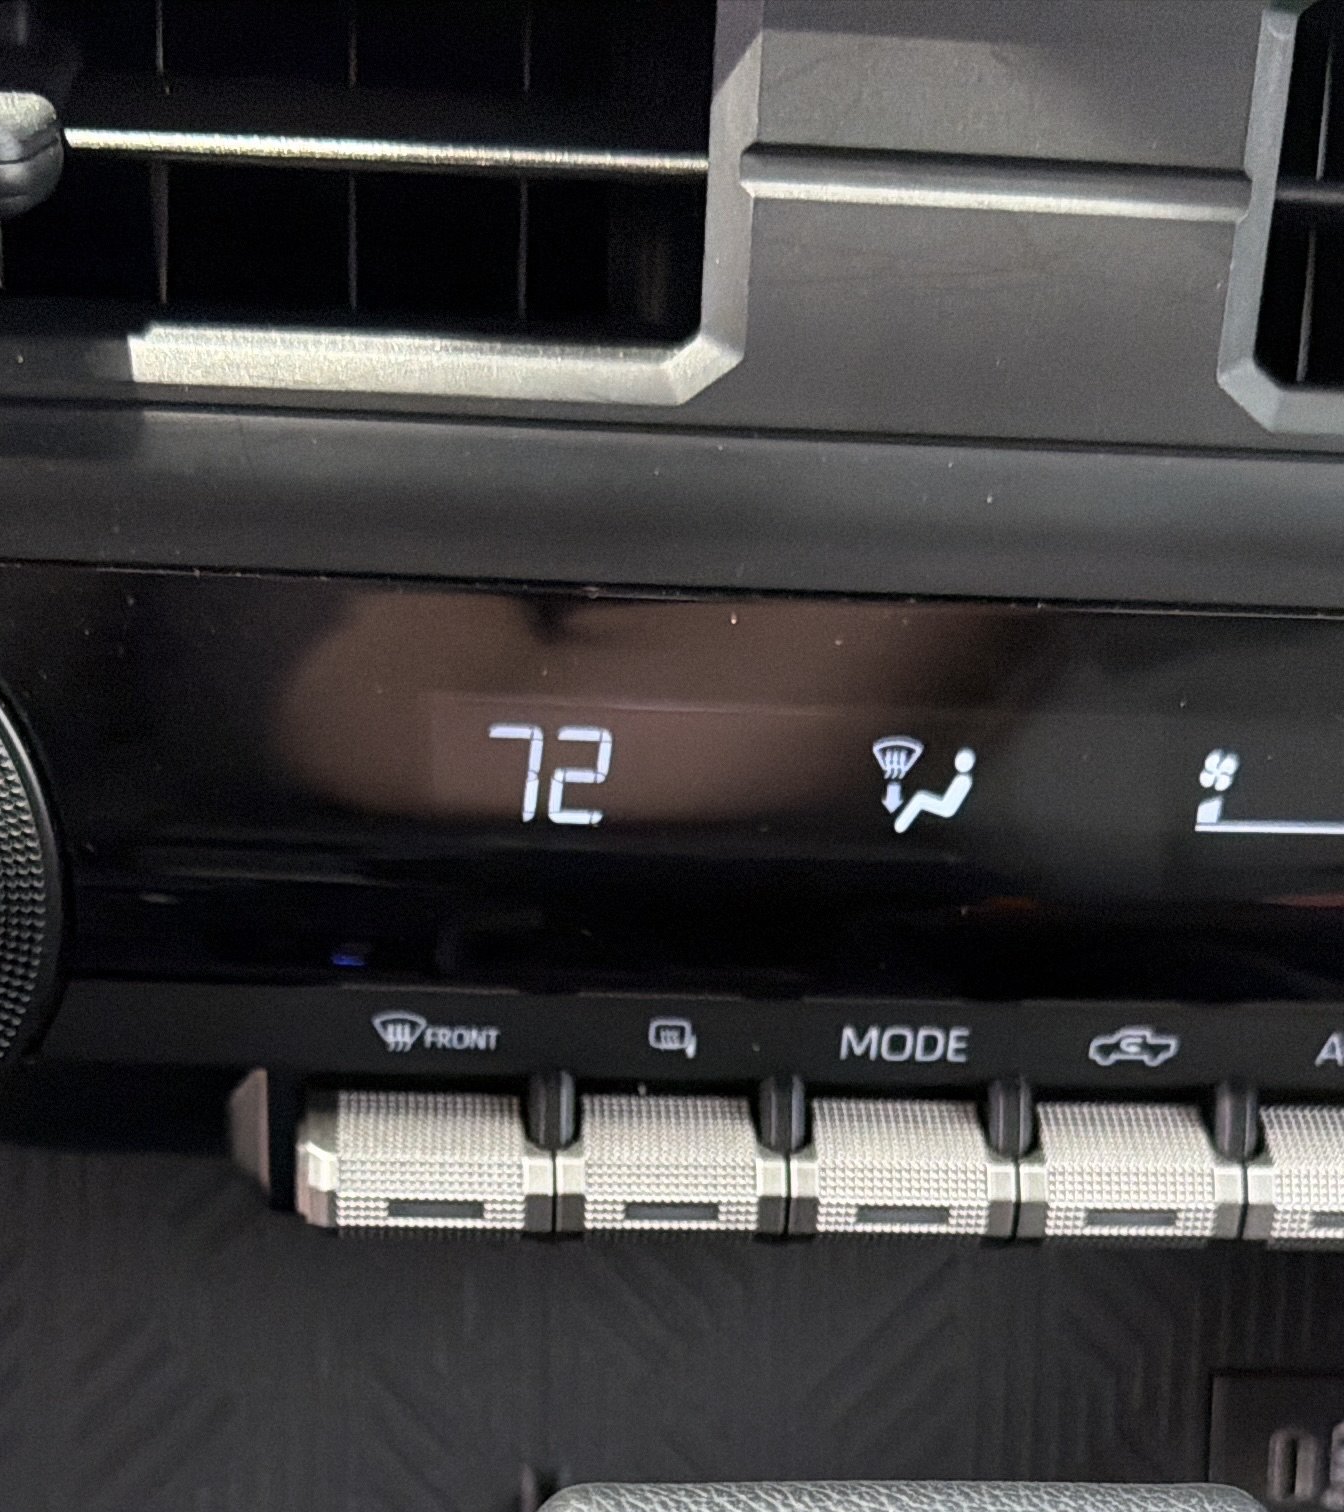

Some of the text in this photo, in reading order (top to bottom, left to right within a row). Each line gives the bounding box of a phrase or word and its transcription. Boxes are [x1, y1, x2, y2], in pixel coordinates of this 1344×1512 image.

[488, 723, 613, 825] 72
[423, 1025, 502, 1051] FRONT
[838, 1024, 972, 1064] MODE
